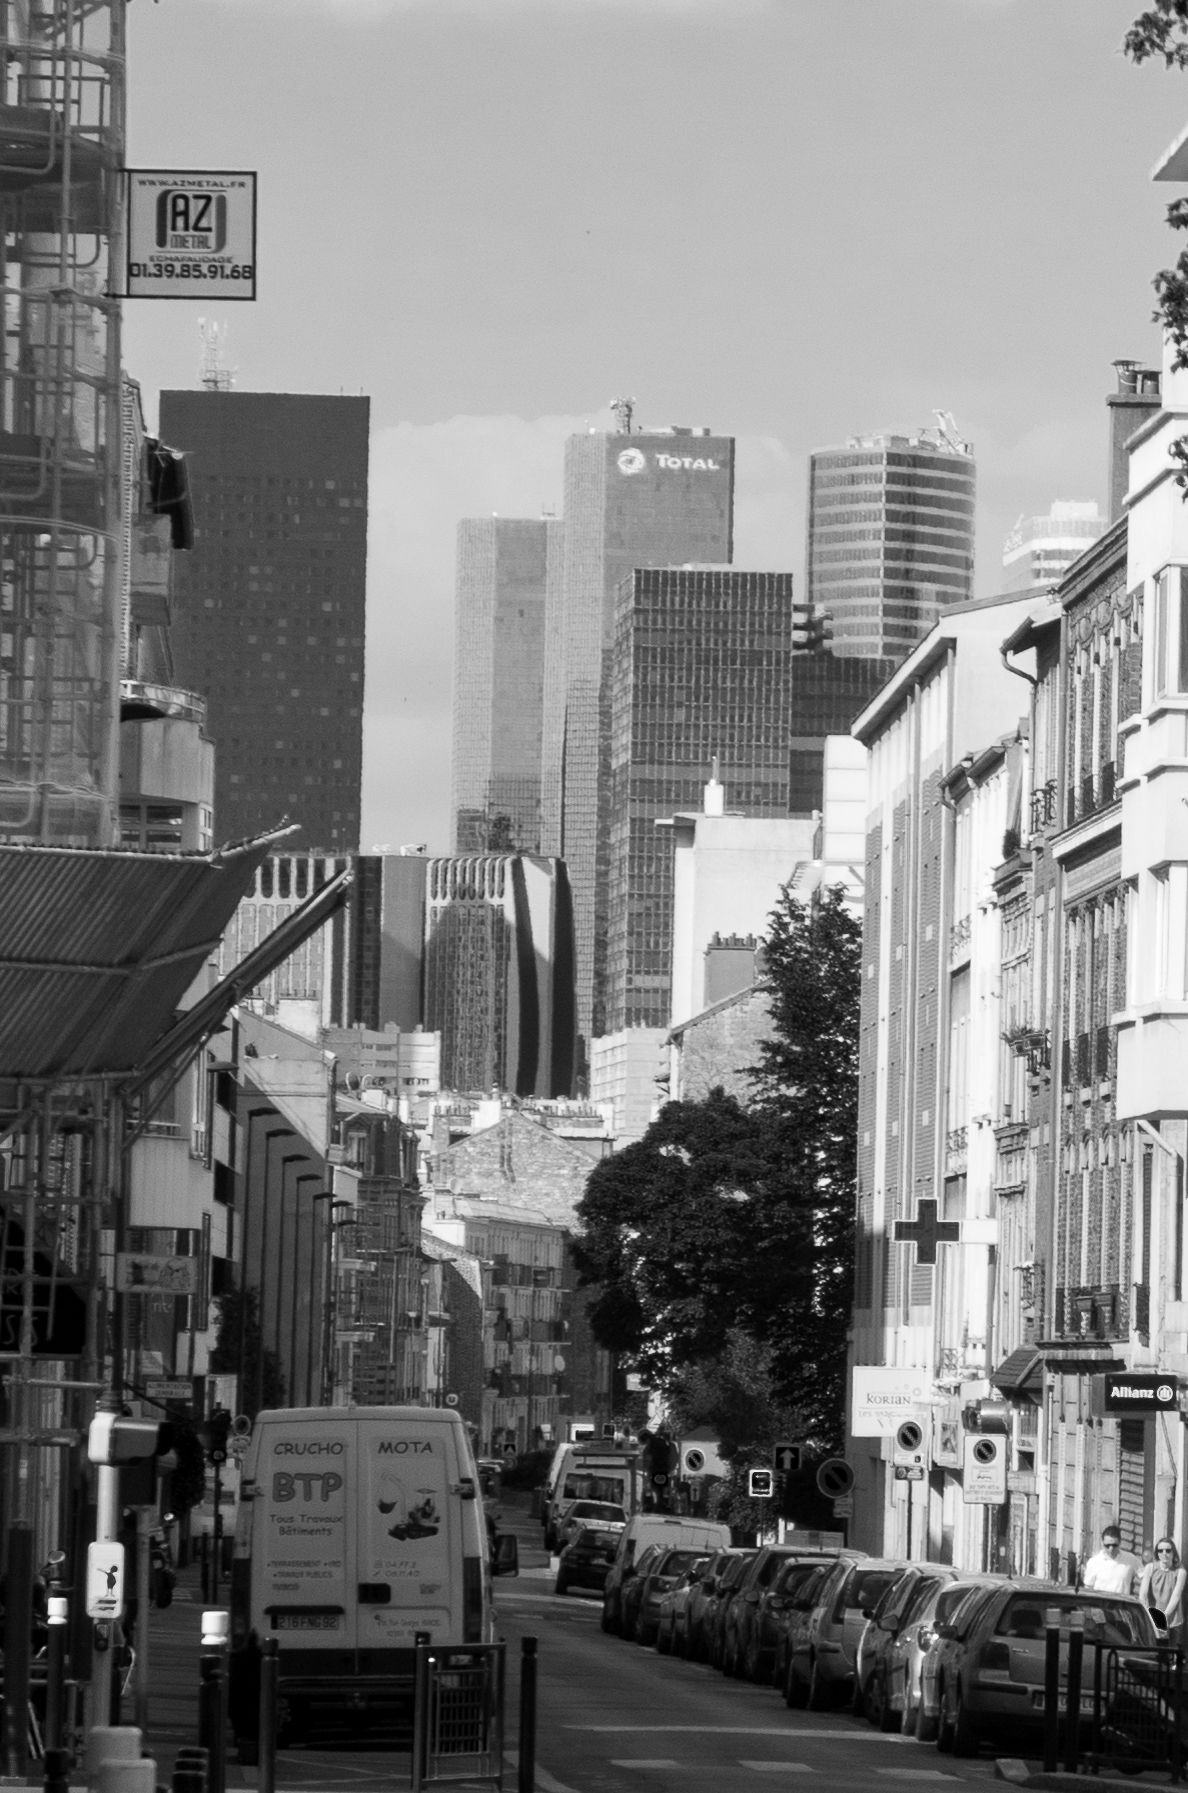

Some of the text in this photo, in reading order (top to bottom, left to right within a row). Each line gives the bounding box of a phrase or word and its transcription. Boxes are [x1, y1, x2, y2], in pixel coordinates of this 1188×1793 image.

[170, 193, 213, 233] AZ
[170, 234, 212, 249] METAL
[129, 262, 253, 280] 01.39.85.91.68
[655, 454, 721, 471] TOTAL
[1111, 1386, 1154, 1399] Allianz
[273, 1441, 434, 1456] CRUCHO MOTA
[272, 1471, 343, 1503] BTP
[269, 1514, 344, 1524] Tous Travaux
[278, 1525, 333, 1537] Bâtiments
